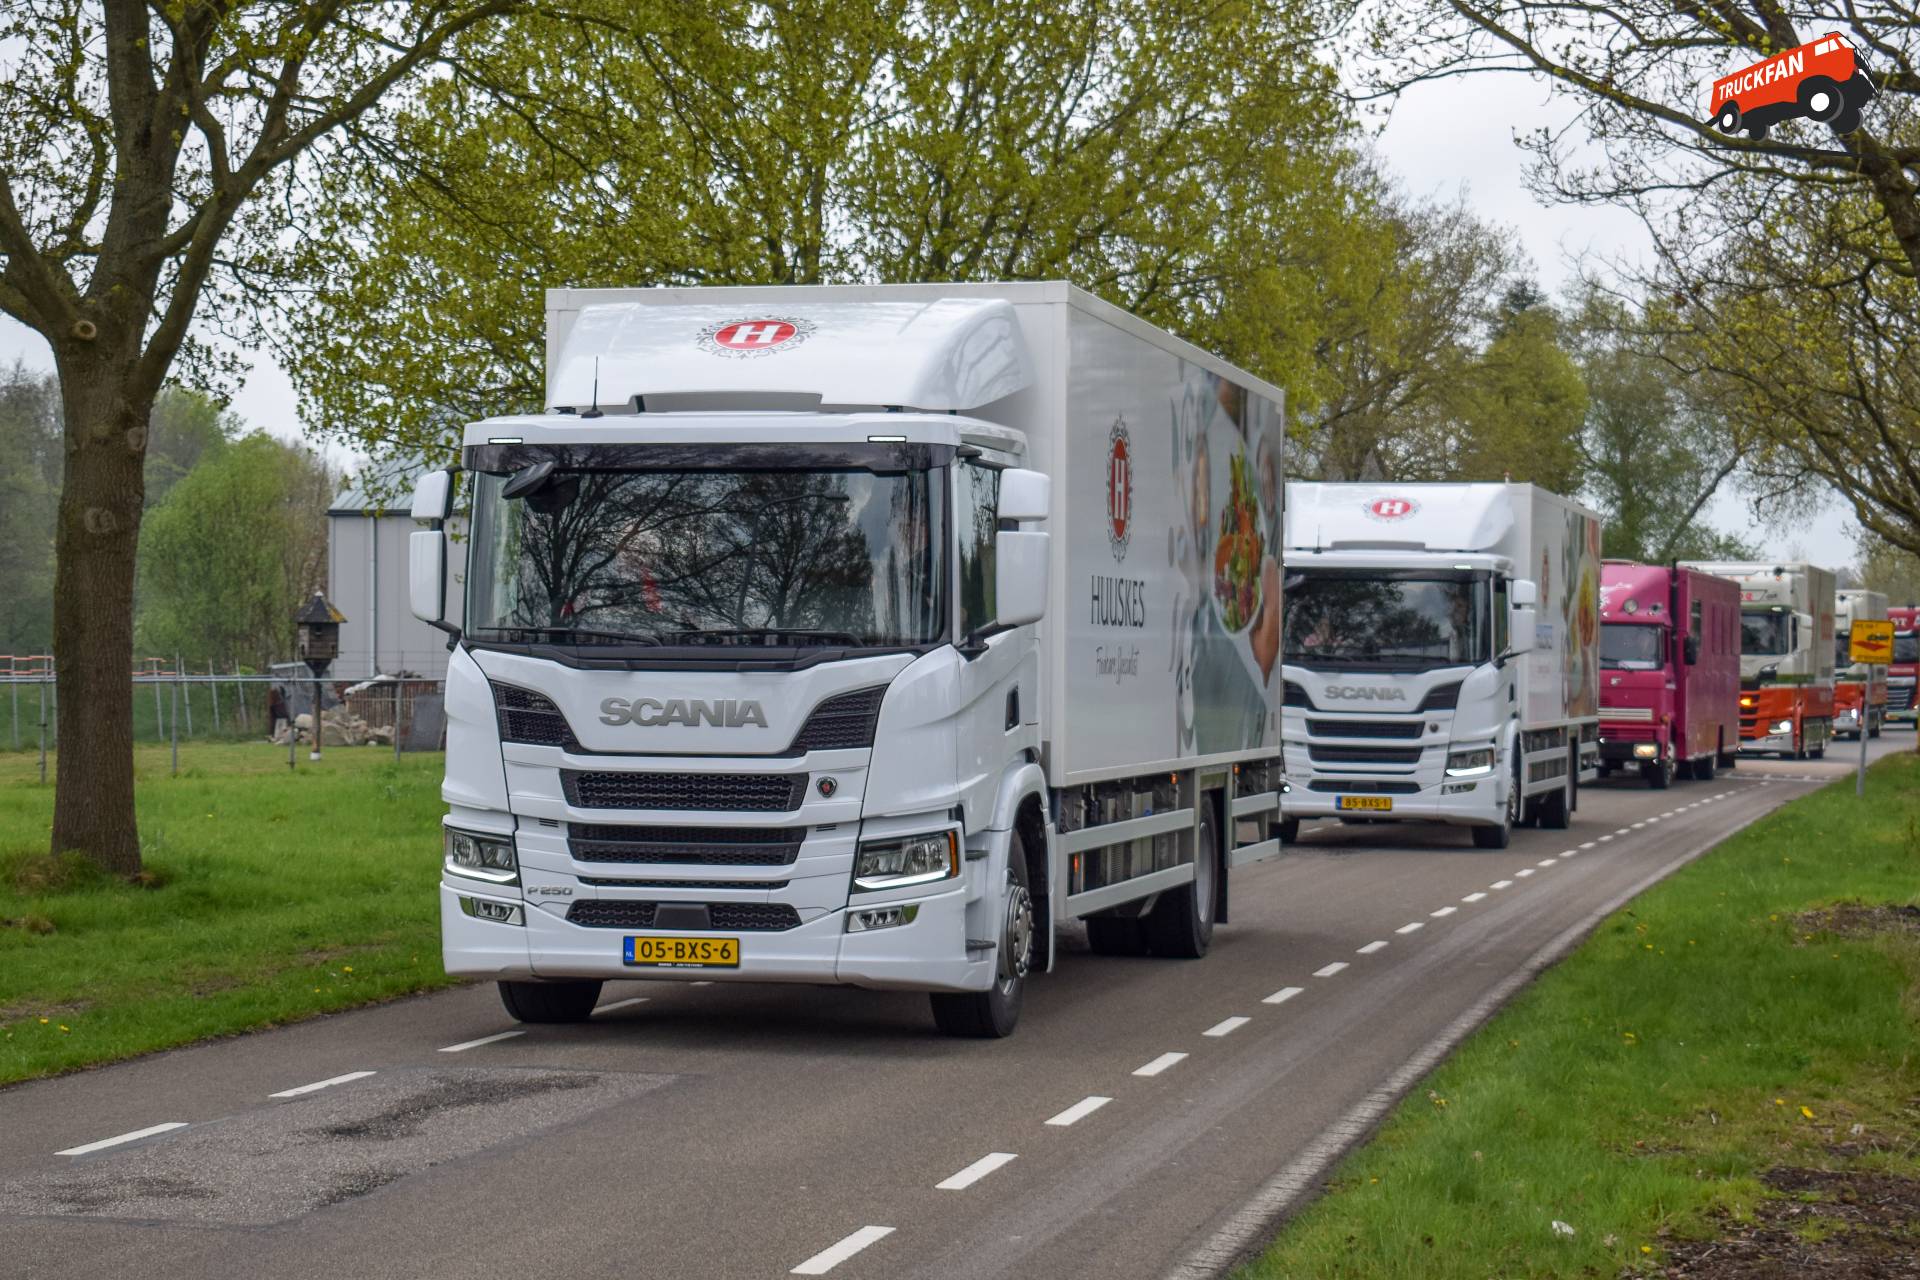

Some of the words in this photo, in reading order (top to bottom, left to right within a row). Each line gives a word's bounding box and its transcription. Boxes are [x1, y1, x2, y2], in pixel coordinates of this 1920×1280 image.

[731, 325, 781, 344] H
[1114, 458, 1125, 520] H
[1380, 502, 1402, 514] H
[1091, 575, 1145, 628] HUUSKES
[1324, 685, 1406, 701] SCANIA
[599, 697, 769, 729] SCANIA
[527, 886, 539, 895] P
[540, 886, 573, 896] 250
[641, 941, 731, 960] 05-BXS-6
